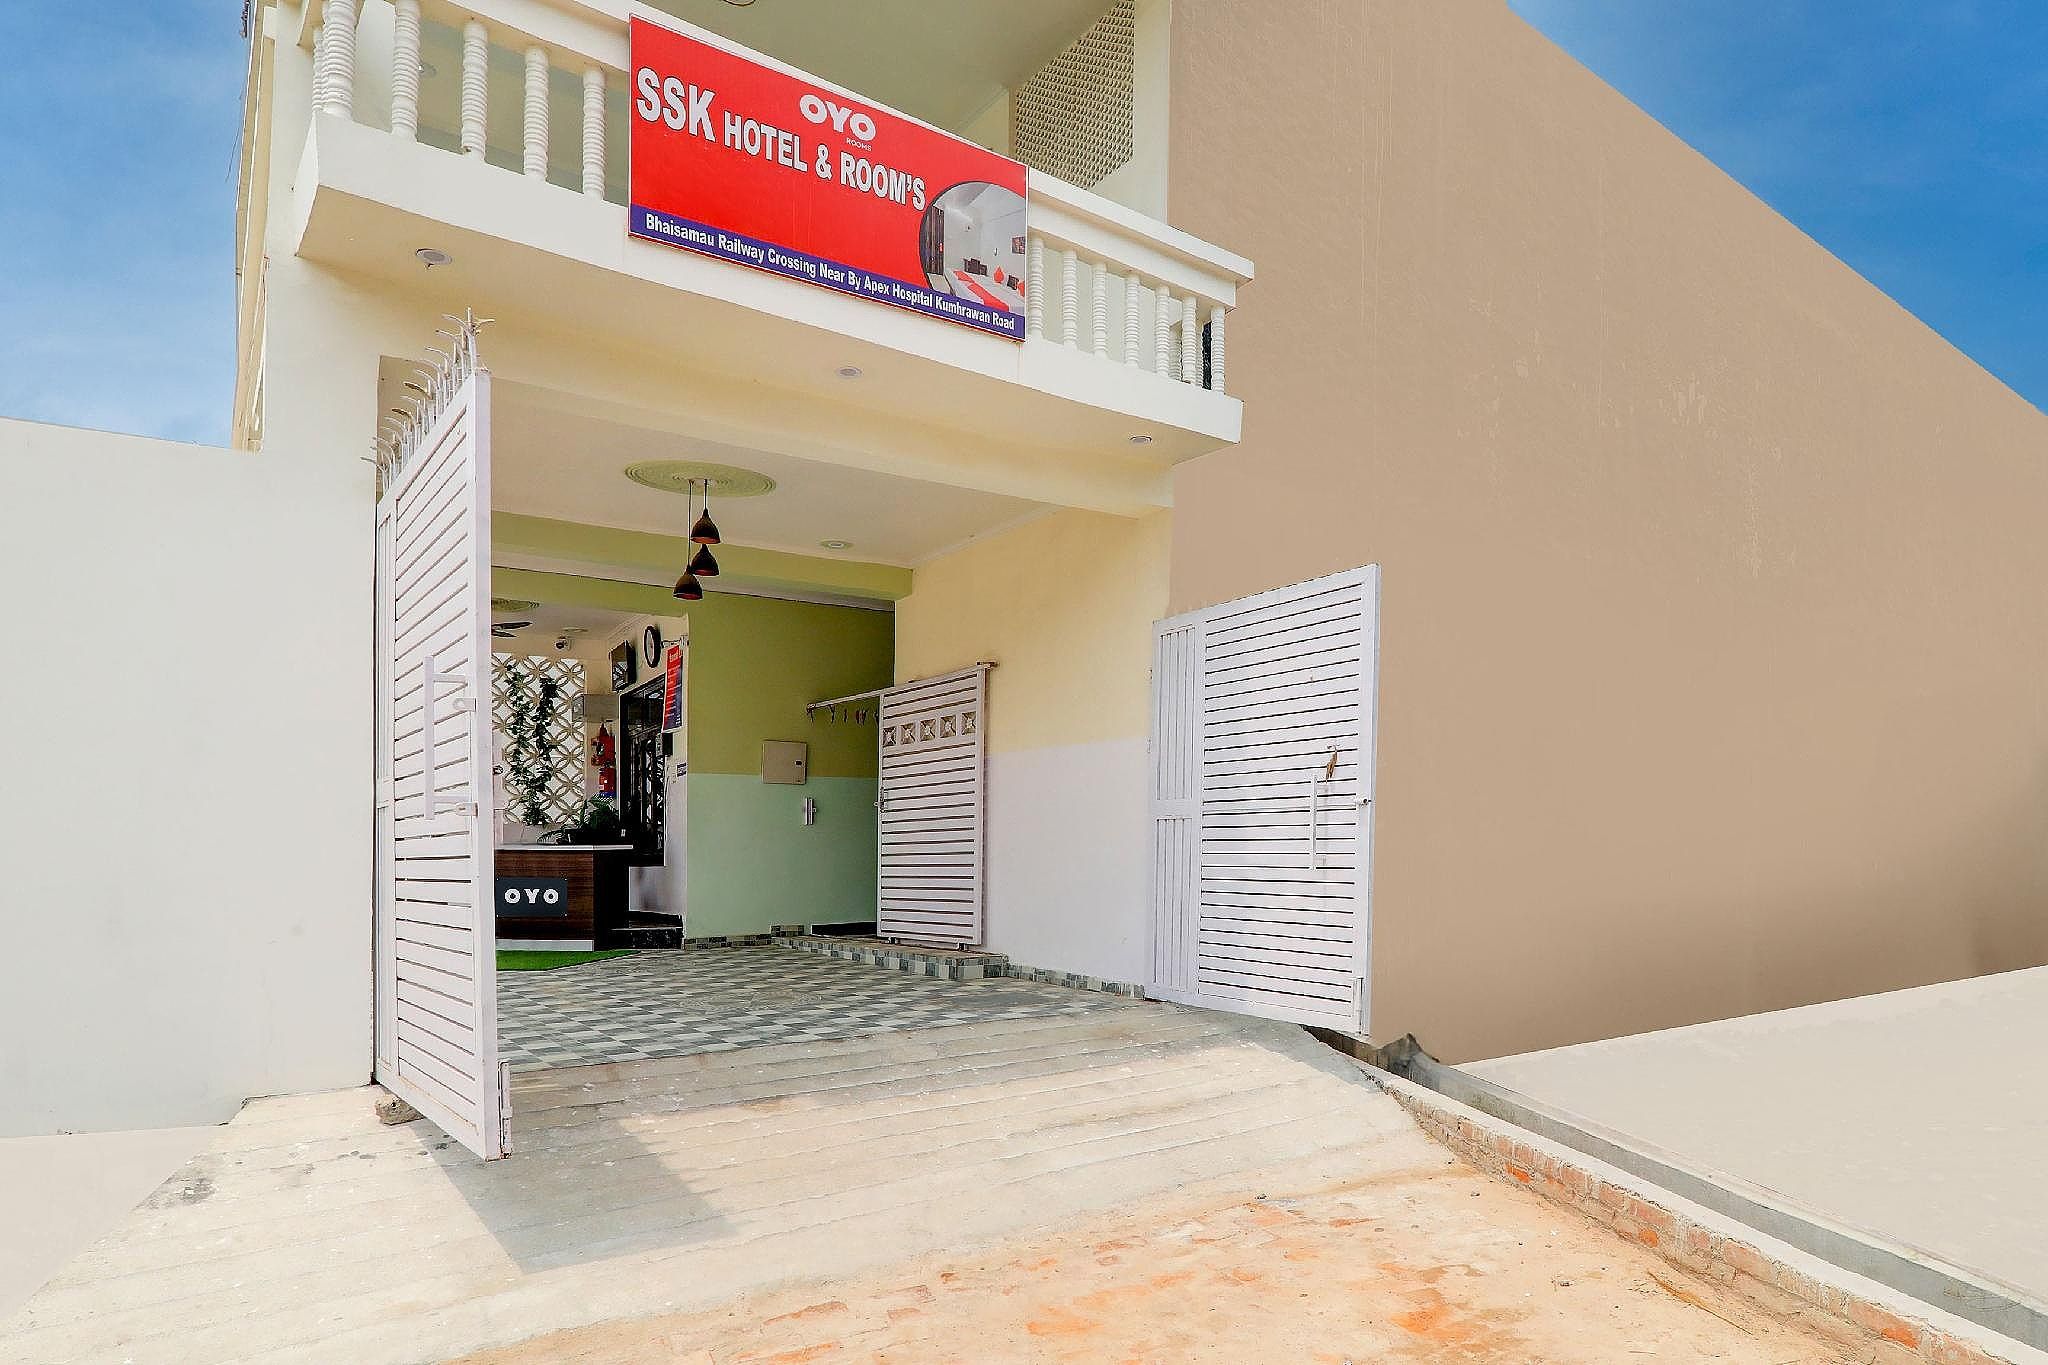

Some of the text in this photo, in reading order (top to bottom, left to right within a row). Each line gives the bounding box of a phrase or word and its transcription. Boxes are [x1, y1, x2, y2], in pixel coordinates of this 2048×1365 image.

[636, 66, 926, 211] SSK HOTEL & ROOM'S
[799, 94, 876, 141] OYO
[846, 137, 872, 152] ROOMS
[646, 213, 1015, 331] Bhaisamau Railway Crossing Near By Apex Hospital Kumhrawan Road
[504, 888, 559, 904] OYO
